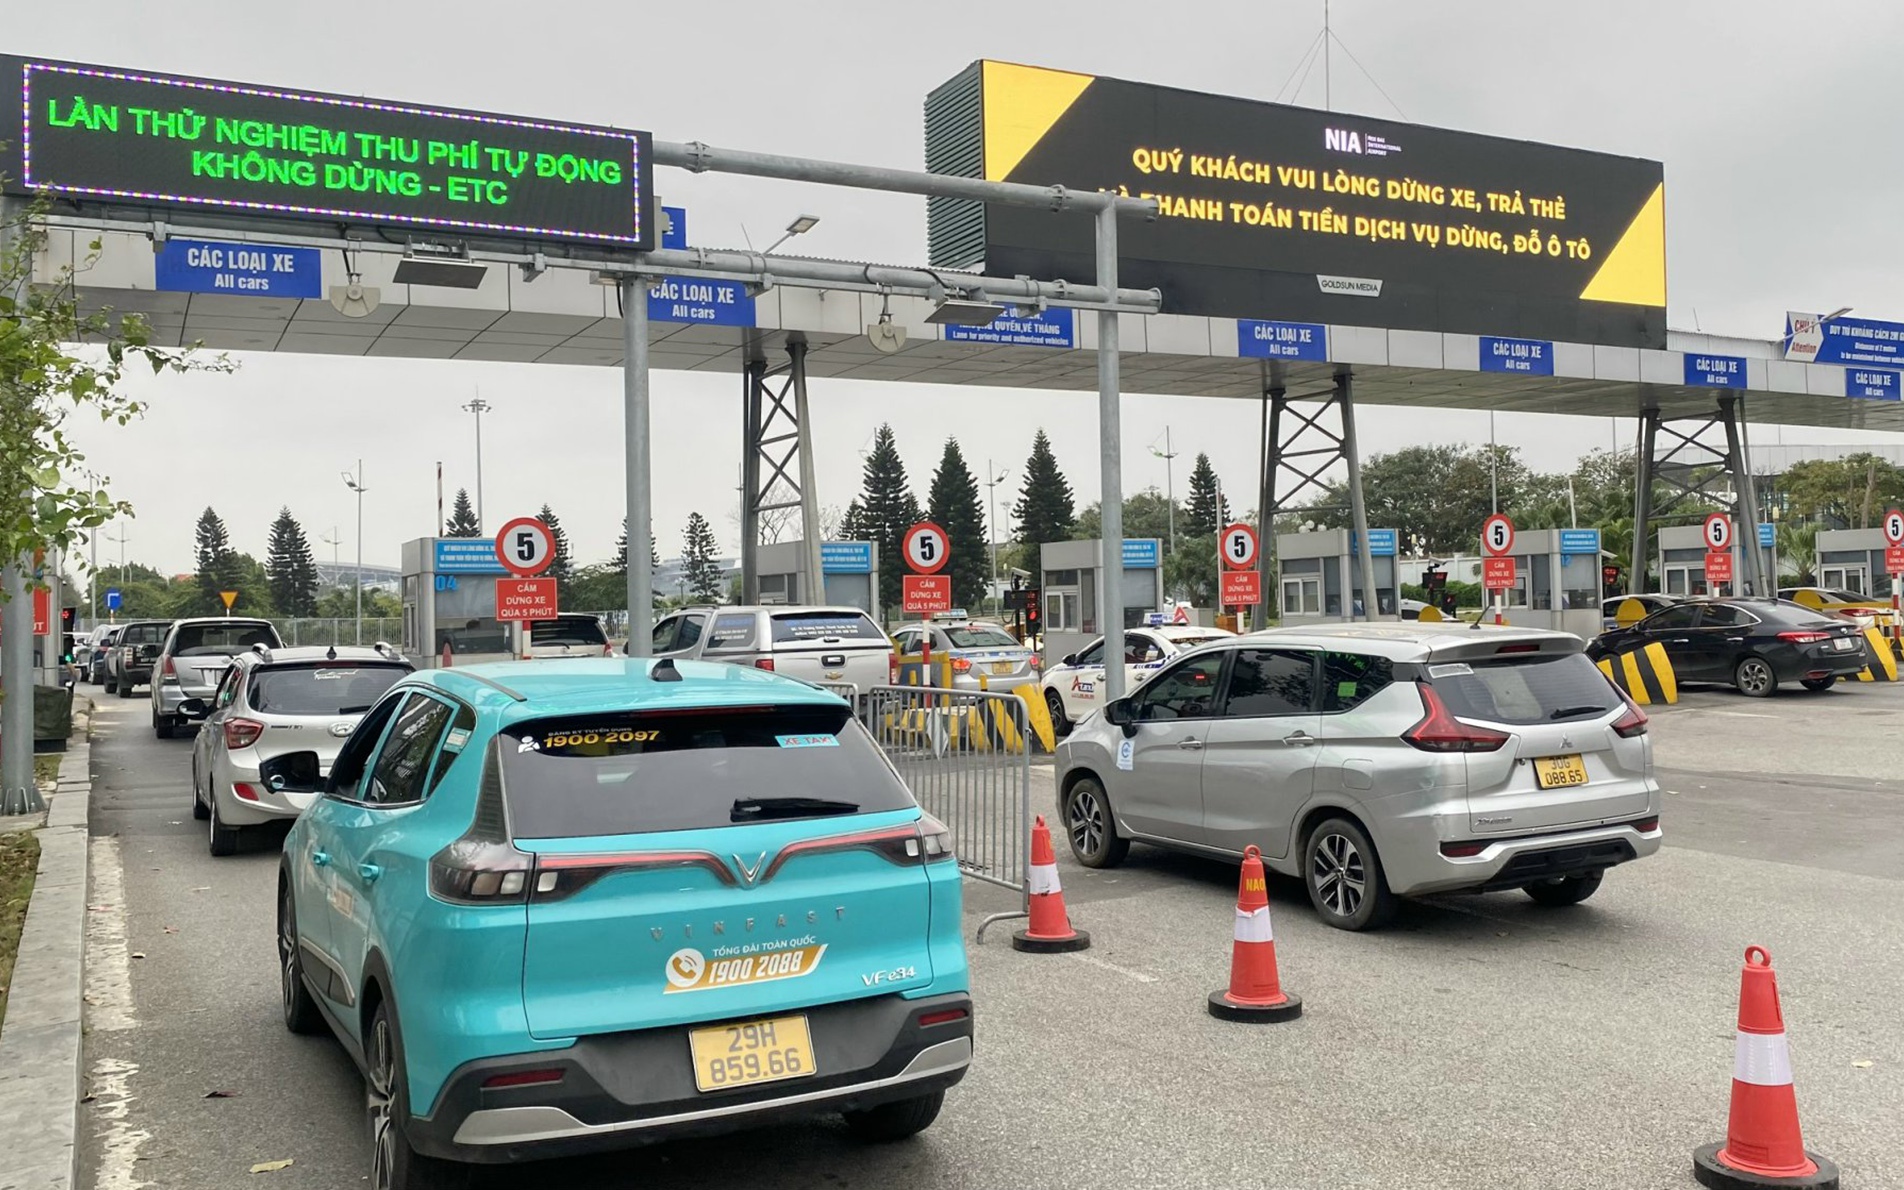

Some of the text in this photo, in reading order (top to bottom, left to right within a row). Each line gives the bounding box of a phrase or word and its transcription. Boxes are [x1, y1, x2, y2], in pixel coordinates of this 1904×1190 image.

[215, 117, 347, 157] NGHIỆM
[353, 132, 419, 164] THU
[427, 140, 479, 170] PHÍ
[484, 147, 529, 179] TỰ
[1325, 127, 1362, 154] NIA
[192, 149, 316, 187] KHÔNG
[324, 159, 422, 197] DỪNG
[447, 176, 508, 205] ETC
[1132, 148, 1567, 220] QUÝ KHÁCH VUI LÒNG DỪNG XE, TRẢ THẺ
[1229, 202, 1293, 229] TOÁN
[1298, 206, 1349, 235] TIỀN
[1354, 217, 1406, 243] DỊCH
[1411, 223, 1442, 248] VỤ
[1446, 224, 1509, 255] DỪNG,
[1513, 229, 1543, 255] ĐỖ
[1547, 234, 1563, 258] Ô
[1566, 238, 1592, 260] TÔ
[187, 245, 294, 274] CÁC LOẠI XE
[214, 273, 269, 290] All cars
[1321, 279, 1378, 292] GOLDSUN MEDIA
[651, 279, 735, 305] CÁC LOẠI XE
[672, 304, 715, 319] All cars
[1034, 322, 1060, 335] THÁNG
[1254, 323, 1312, 344] CÁC LOẠI XE
[1269, 344, 1299, 355] All cars
[1493, 340, 1542, 359] CÁC LOẠI XE
[1696, 357, 1738, 374] CÁC LOẠI XE
[1883, 375, 1892, 386] XE
[1494, 525, 1504, 546] 5
[1713, 523, 1722, 542] 5
[1892, 519, 1899, 537] 5
[517, 532, 535, 561] 5
[920, 536, 934, 561] 5
[1234, 535, 1246, 558] 5
[435, 575, 457, 592] 04
[517, 582, 537, 592] CẤM
[919, 579, 935, 588] CẤM
[534, 596, 546, 604] XE
[932, 591, 942, 599] XE
[529, 606, 553, 616] PHÚT
[543, 730, 660, 748] 1900 2097
[1545, 769, 1583, 786] 088.65
[650, 906, 846, 941] VINFAST
[762, 939, 787, 951] TOÀN
[789, 934, 816, 949] QUỐC
[708, 951, 804, 984] 1900 2088
[861, 966, 918, 986] VF e34
[726, 1022, 777, 1052] 29H
[709, 1047, 802, 1084] 859.66
